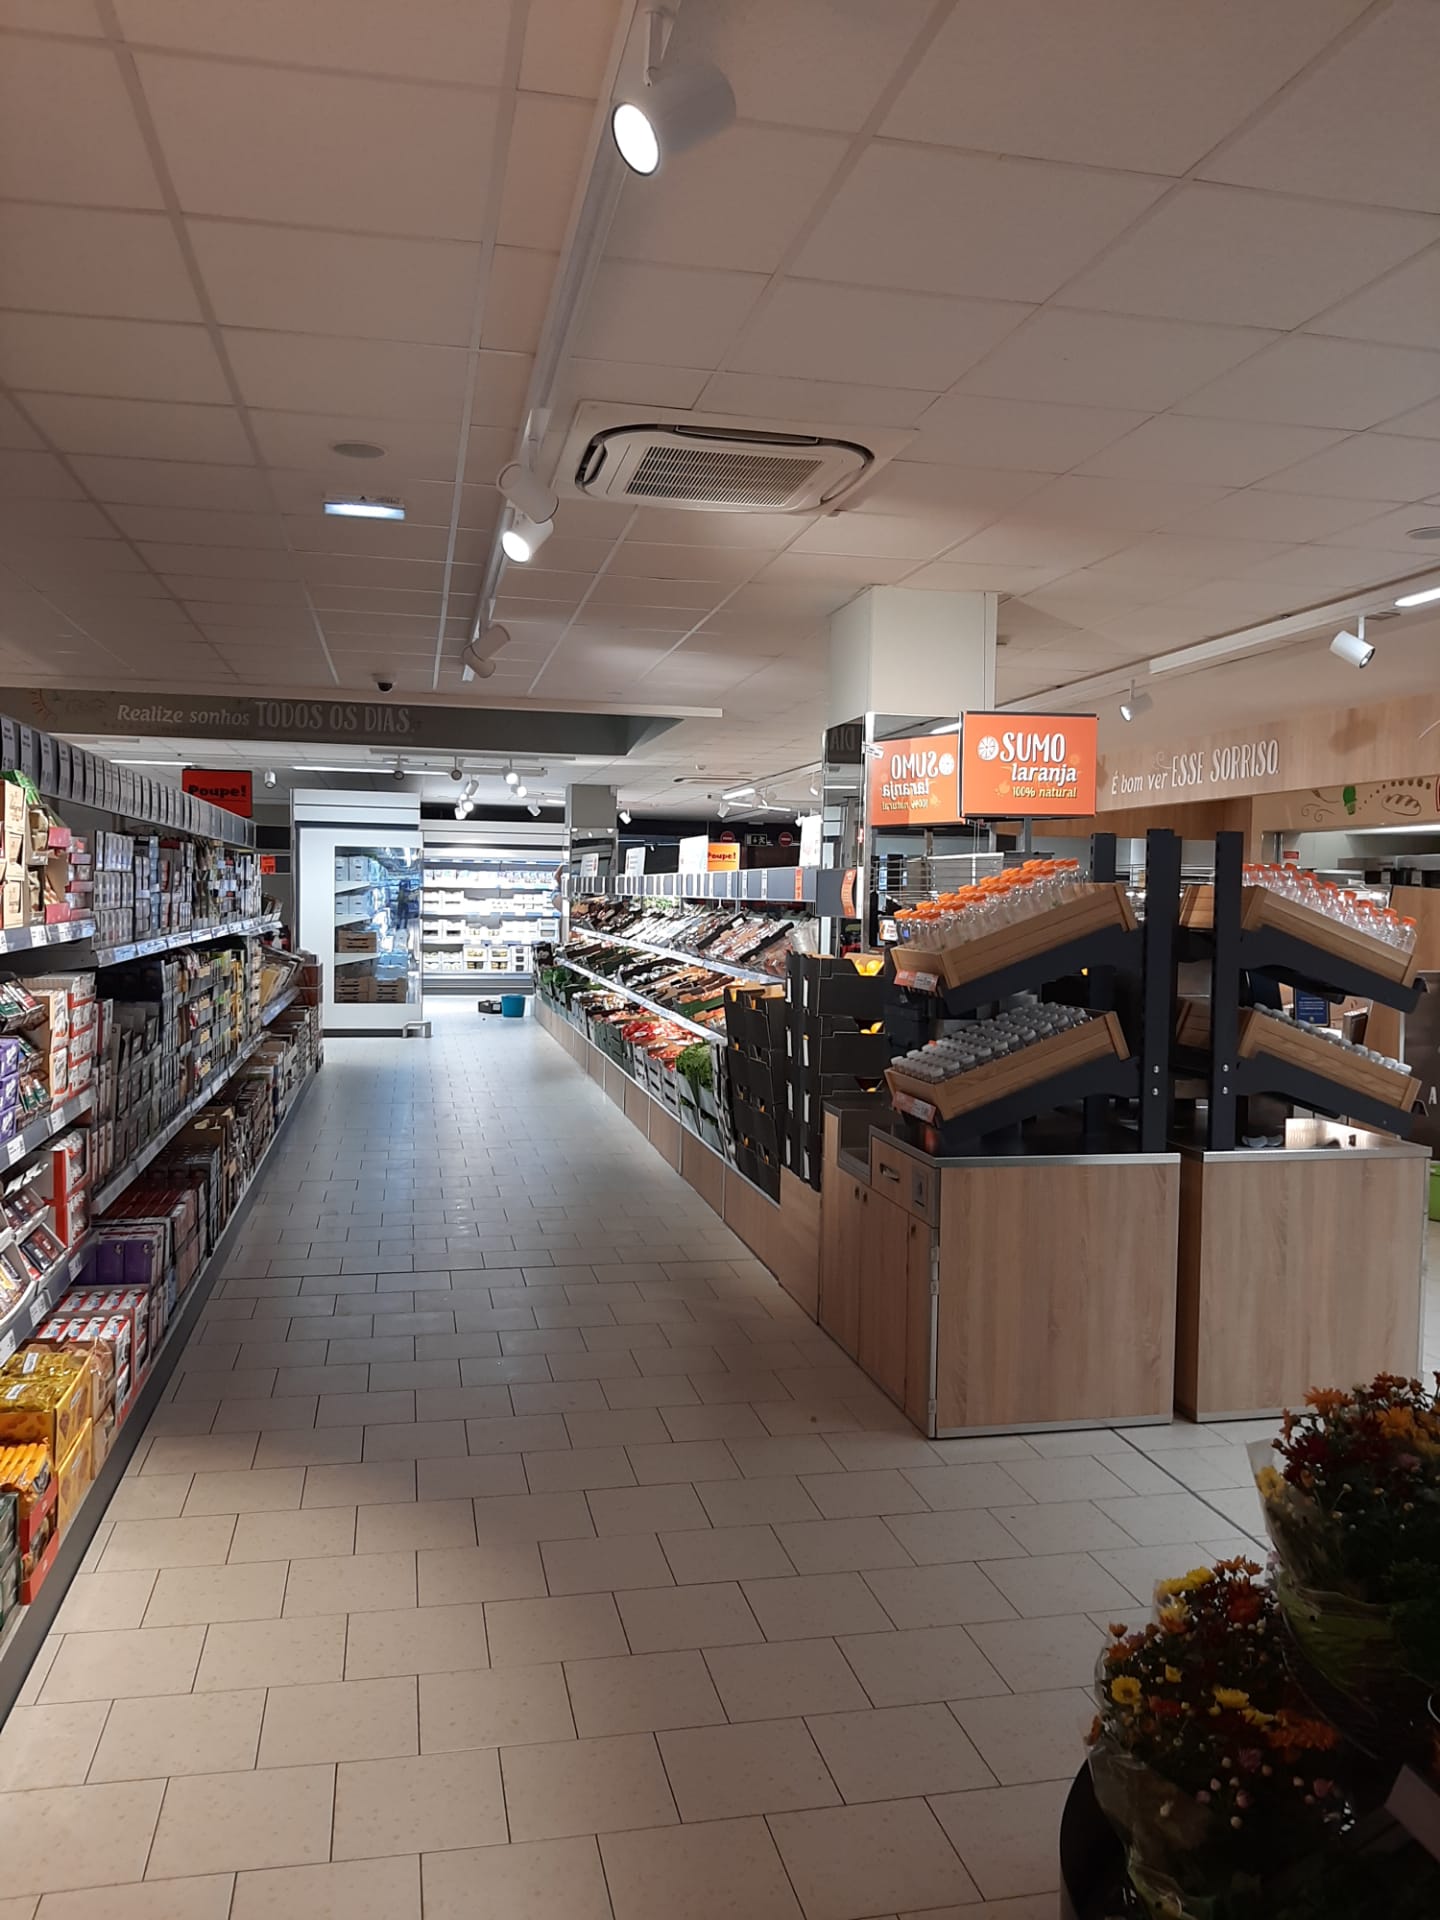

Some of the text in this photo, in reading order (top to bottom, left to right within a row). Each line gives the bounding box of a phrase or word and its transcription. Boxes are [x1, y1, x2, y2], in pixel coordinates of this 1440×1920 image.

[117, 702, 415, 733] Realize sonhos TODOS OS DIAS.
[1000, 732, 1065, 762] SUMO
[1012, 763, 1077, 787] laranja
[1111, 739, 1279, 795] É bom ver ESSE SORRISO.
[188, 784, 246, 799] Poupe!
[1013, 786, 1077, 798] 100% natural
